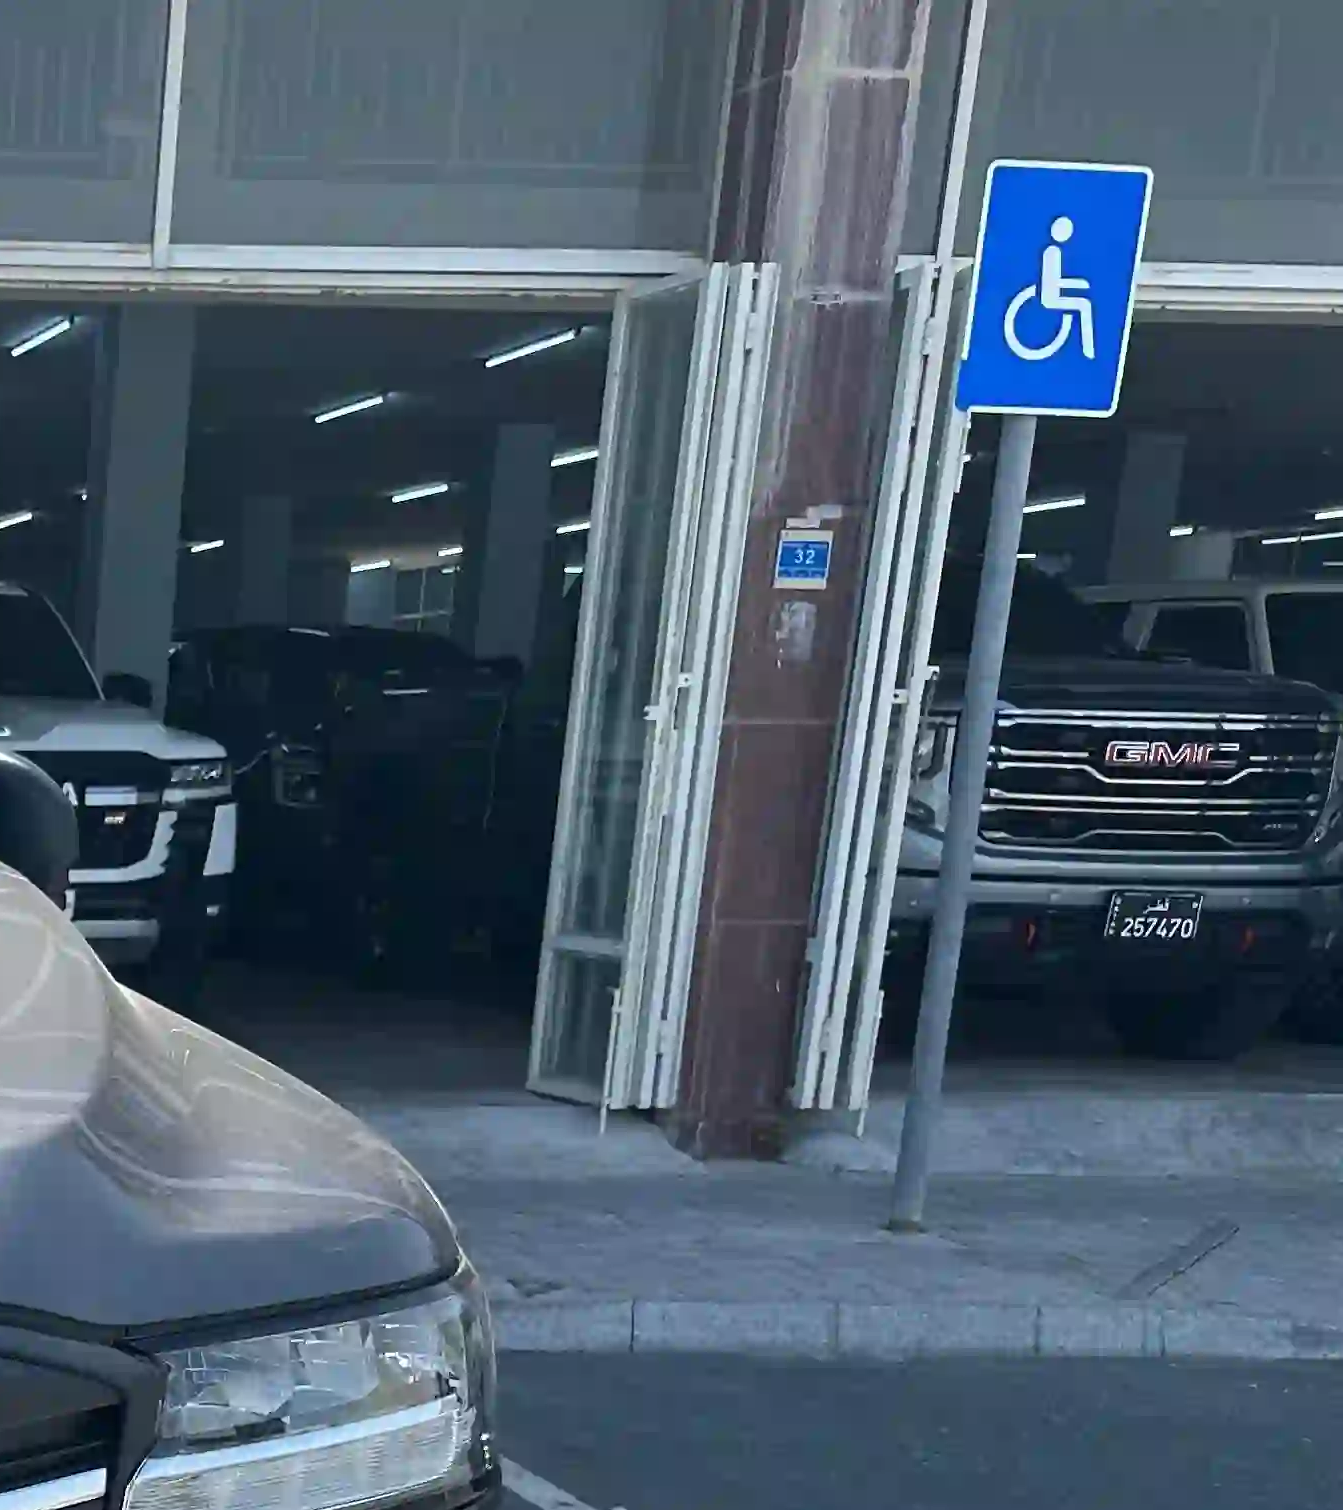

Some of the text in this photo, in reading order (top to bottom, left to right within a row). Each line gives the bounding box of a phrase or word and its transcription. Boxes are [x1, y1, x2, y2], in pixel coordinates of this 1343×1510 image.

[795, 549, 815, 565] 32
[1104, 740, 1240, 767] GMC
[1120, 917, 1194, 939] 257470
